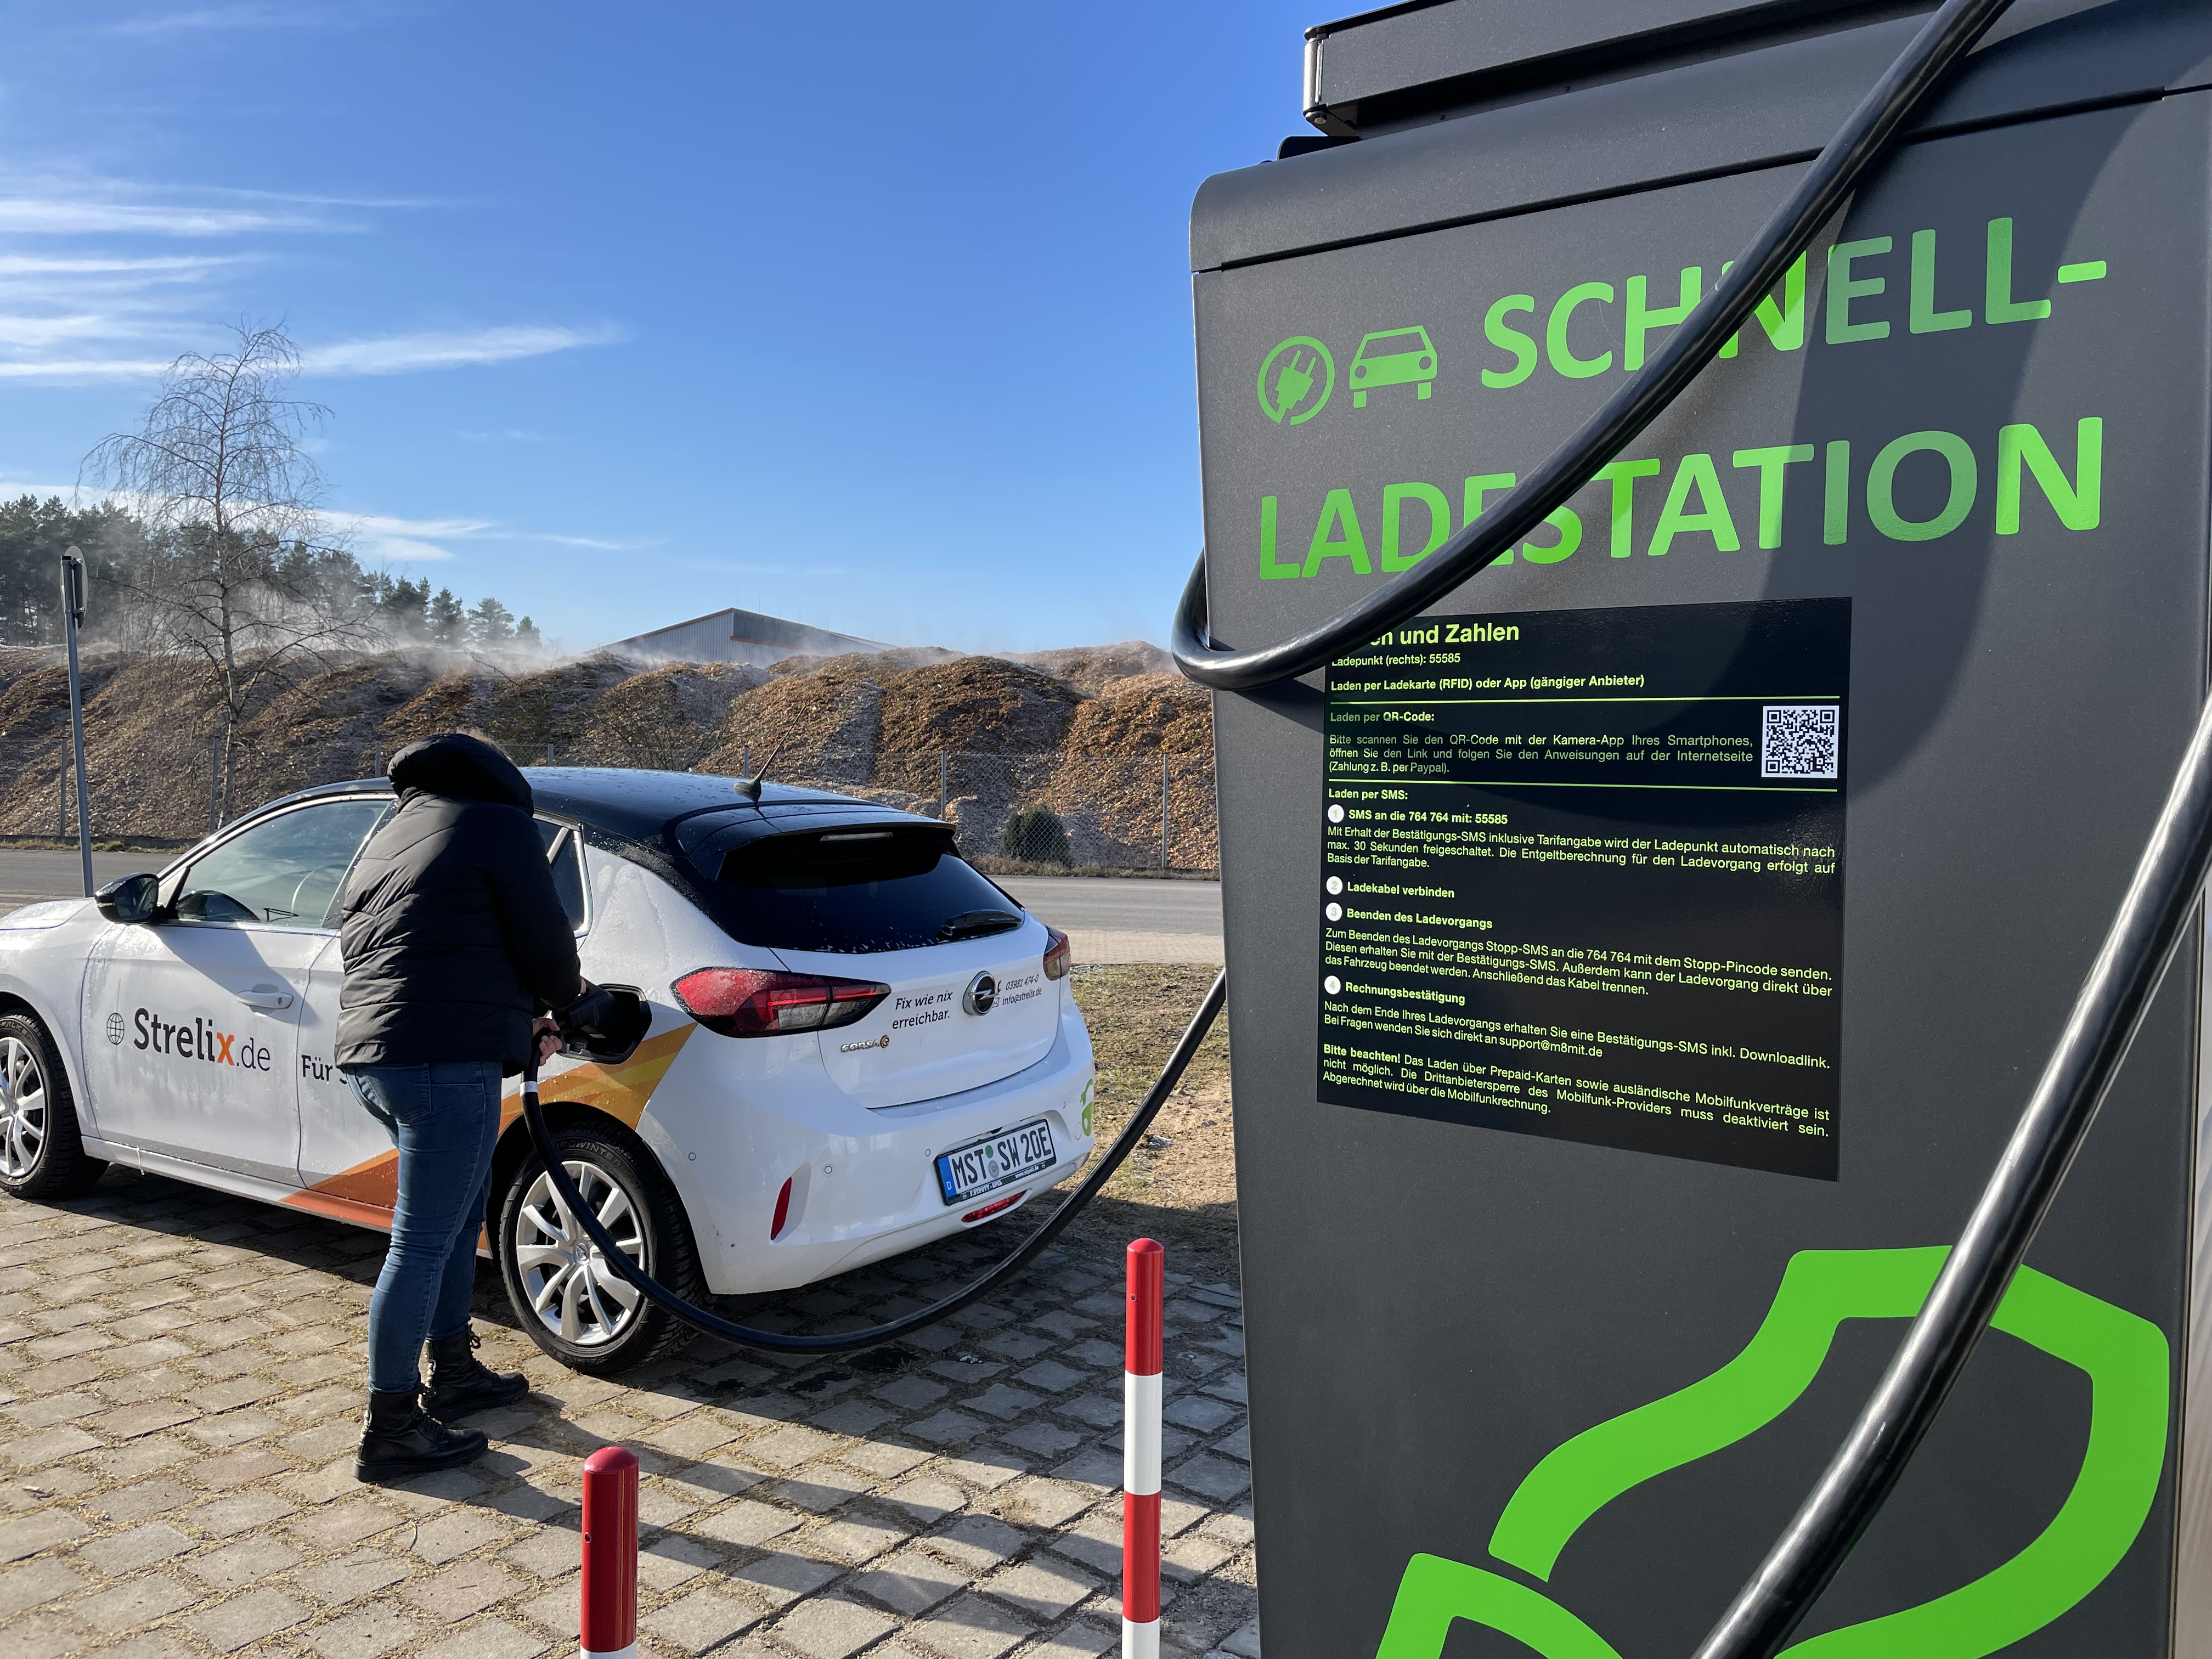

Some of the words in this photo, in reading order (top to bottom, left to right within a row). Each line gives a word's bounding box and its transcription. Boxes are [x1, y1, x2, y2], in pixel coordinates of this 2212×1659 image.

[1481, 217, 2107, 389] SCHNELL-
[1400, 625, 1439, 645] und
[1445, 622, 1519, 643] Zahlen
[1386, 653, 1426, 667] (rechts):
[1429, 652, 1461, 664] 55585
[1331, 681, 1362, 691] Laden
[1364, 682, 1381, 692] per
[1384, 679, 1436, 690] Ladekarte
[1439, 678, 1472, 691] (RFID)
[1475, 678, 1502, 689] oder
[1503, 677, 1527, 690] App
[1530, 676, 1586, 690] (gängiger
[1588, 674, 1644, 687] Anbieter)
[1330, 712, 1361, 722] Laden
[1363, 714, 1380, 724] per
[1383, 711, 1435, 722] QR-Code:
[1329, 788, 1359, 799] Laden
[1362, 791, 1379, 801] per
[1381, 789, 1408, 800] SMS:
[1348, 809, 1372, 820] SMS
[1374, 812, 1387, 820] an
[1390, 810, 1406, 821] die
[1408, 811, 1427, 822] 764
[1430, 812, 1449, 822] 764
[1451, 812, 1472, 823] mit:
[1475, 813, 1508, 825] 55585
[1328, 826, 1342, 836] Mit
[1345, 826, 1372, 837] Erhalt
[1374, 828, 1390, 838] der
[1392, 828, 1486, 843] Bestätigungs-SMS
[1489, 832, 1534, 844] inklusive
[1537, 834, 1602, 849] Tarifangabe
[1604, 837, 1629, 849] wird
[1632, 838, 1652, 849] der
[1654, 839, 1719, 854] Ladepunkt
[1721, 843, 1799, 856] automatisch
[1803, 846, 1835, 857] nach
[1327, 842, 1350, 850] max.
[1354, 840, 1366, 851] 30
[1370, 841, 1419, 853] Sekunden
[1423, 843, 1494, 857] freigeschaltet.
[1499, 847, 1517, 858] Die
[1521, 848, 1626, 866] Entgeltberechnung
[1631, 853, 1648, 865] für
[1652, 854, 1675, 866] den
[1681, 855, 1761, 873] Ladevorgang
[1767, 860, 1808, 875] erfolgt
[1814, 862, 1836, 874] auf
[1327, 853, 1352, 864] Basis
[1353, 854, 1370, 865] der
[1370, 855, 1430, 869] Tarifangabe.
[1347, 881, 1400, 895] Ladekabel
[1402, 885, 1454, 898] verbinden
[1347, 908, 1391, 921] Beenden
[1393, 912, 1413, 923] des
[1415, 913, 1493, 930] Ladevorgangs
[1325, 927, 1346, 939] Zum
[1348, 929, 1391, 943] Beenden
[1392, 933, 1410, 944] des
[1413, 934, 1484, 952] Ladevorgangs
[1486, 940, 1549, 956] Stopp-SMS
[1551, 949, 1565, 957] an
[1567, 947, 1584, 959] die
[1586, 949, 1607, 961] 764
[1610, 951, 1632, 963] 764
[1634, 953, 1652, 965] mit
[1655, 955, 1681, 967] dem
[1683, 957, 1778, 976] Stopp-Pincode
[1780, 967, 1832, 980] senden.
[1325, 941, 1357, 953] Diesen
[1359, 944, 1398, 957] erhalten
[1400, 947, 1417, 958] Sie
[1419, 950, 1435, 960] mit
[1437, 951, 1454, 962] der
[1457, 952, 1559, 972] Bestätigungs-SMS.
[1562, 962, 1620, 978] Außerdem
[1624, 967, 1652, 980] kann
[1655, 970, 1675, 983] der
[1678, 972, 1759, 992] Ladevorgang
[1762, 980, 1799, 994] direkt
[1802, 983, 1833, 997] über
[1325, 954, 1342, 966] das
[1344, 956, 1387, 972] Fahrzeug
[1389, 960, 1429, 974] beendet
[1430, 966, 1471, 978] werden.
[1472, 968, 1544, 985] Anschließend
[1545, 975, 1566, 987] das
[1568, 977, 1600, 990] Kabel
[1601, 980, 1649, 995] trennen.
[1002, 986, 1042, 1006] info@strelix.de
[1006, 978, 1024, 991] 03981
[1345, 981, 1465, 1006] Rechnungsbestätigung
[895, 997, 912, 1010] Fix
[915, 994, 934, 1007] wie
[936, 990, 953, 1003] nix
[892, 1009, 950, 1030] erreichbar.
[133, 1007, 270, 1071] Strelix.de
[1324, 1001, 1348, 1013] Nach
[1351, 1004, 1372, 1015] dem
[1375, 1006, 1400, 1019] Ende
[1402, 1009, 1426, 1022] Ihres
[1429, 1012, 1501, 1032] Ladevorgangs
[1504, 1022, 1547, 1036] erhalten
[1550, 1026, 1568, 1038] Sie
[1570, 1029, 1594, 1041] eine
[1597, 1031, 1708, 1054] Bestätigungs-SMS
[1711, 1044, 1736, 1058] inkl.
[1740, 1047, 1830, 1069] Downloadlink.
[1324, 1014, 1339, 1025] Bei
[1341, 1015, 1373, 1030] Fragen
[1374, 1022, 1413, 1034] wenden
[1414, 1024, 1430, 1036] Sie
[1431, 1027, 1452, 1039] sich
[1454, 1030, 1483, 1043] direkt
[1484, 1035, 1497, 1045] an
[1499, 1037, 1603, 1057] support@m8mit.de
[301, 1054, 333, 1081] Für
[1323, 1070, 1383, 1089] Abgerechnet
[1384, 1080, 1404, 1092] wird
[1406, 1082, 1429, 1095] über
[1430, 1086, 1446, 1098] die
[1447, 1088, 1551, 1115] Mobilfunkrechnung.
[1324, 1043, 1347, 1056] Bitte
[1350, 1047, 1401, 1064] beachten!
[1404, 1054, 1424, 1066] Das
[1427, 1057, 1459, 1071] Laden
[1463, 1062, 1487, 1075] über
[1490, 1065, 1571, 1086] Prepaid-Karten
[1576, 1079, 1609, 1091] sowie
[1613, 1084, 1690, 1102] ausländische
[1695, 1092, 1809, 1120] Mobilfunkverträge
[1814, 1108, 1830, 1121] ist
[1323, 1058, 1346, 1070] nicht
[1353, 1063, 1393, 1076] möglich.
[1401, 1068, 1417, 1080] Die
[1424, 1070, 1520, 1094] Drittanbietersperre
[1528, 1085, 1548, 1098] des
[1556, 1088, 1672, 1115] Mobilfunk-Providers
[1680, 1108, 1714, 1121] muss
[1723, 1112, 1788, 1131] deaktiviert
[1798, 1124, 1829, 1137] sein.
[951, 1149, 987, 1189] MST
[997, 1137, 1021, 1171] SW
[1020, 1126, 1052, 1164] 20E
[946, 1181, 952, 1191] D
